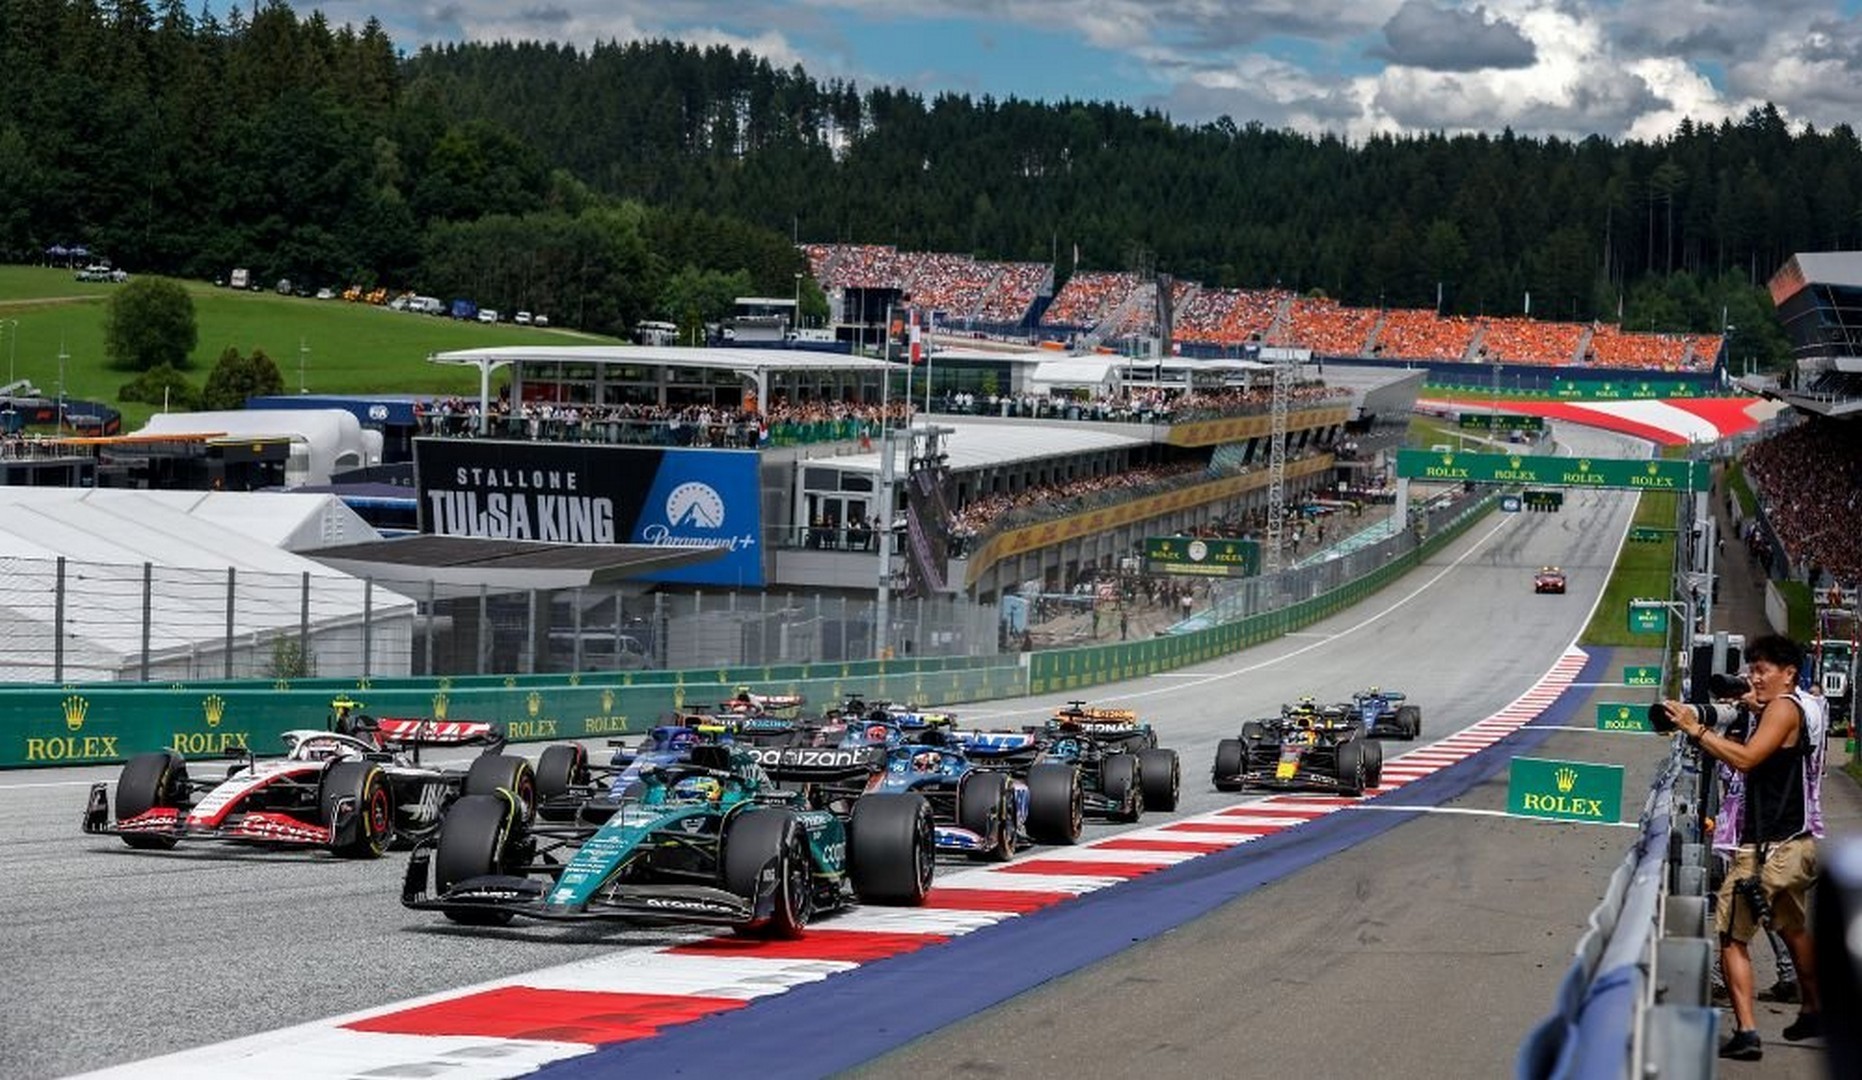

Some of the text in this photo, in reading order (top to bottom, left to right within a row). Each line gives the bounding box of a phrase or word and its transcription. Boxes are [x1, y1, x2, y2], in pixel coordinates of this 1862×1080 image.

[457, 467, 577, 490] STALLONE
[1426, 466, 1468, 478] ROLEX
[1494, 469, 1536, 481] ROLEX
[1563, 472, 1605, 484] ROLEX
[1631, 475, 1673, 487] ROLEX
[427, 490, 615, 544] TULSA KING
[508, 719, 558, 738] ROLEX
[585, 716, 628, 732] ROLEX
[1605, 720, 1642, 730] ROLEX
[26, 737, 120, 760] ROLEX
[172, 732, 249, 755] ROLEX
[1523, 793, 1602, 816] ROLEX
